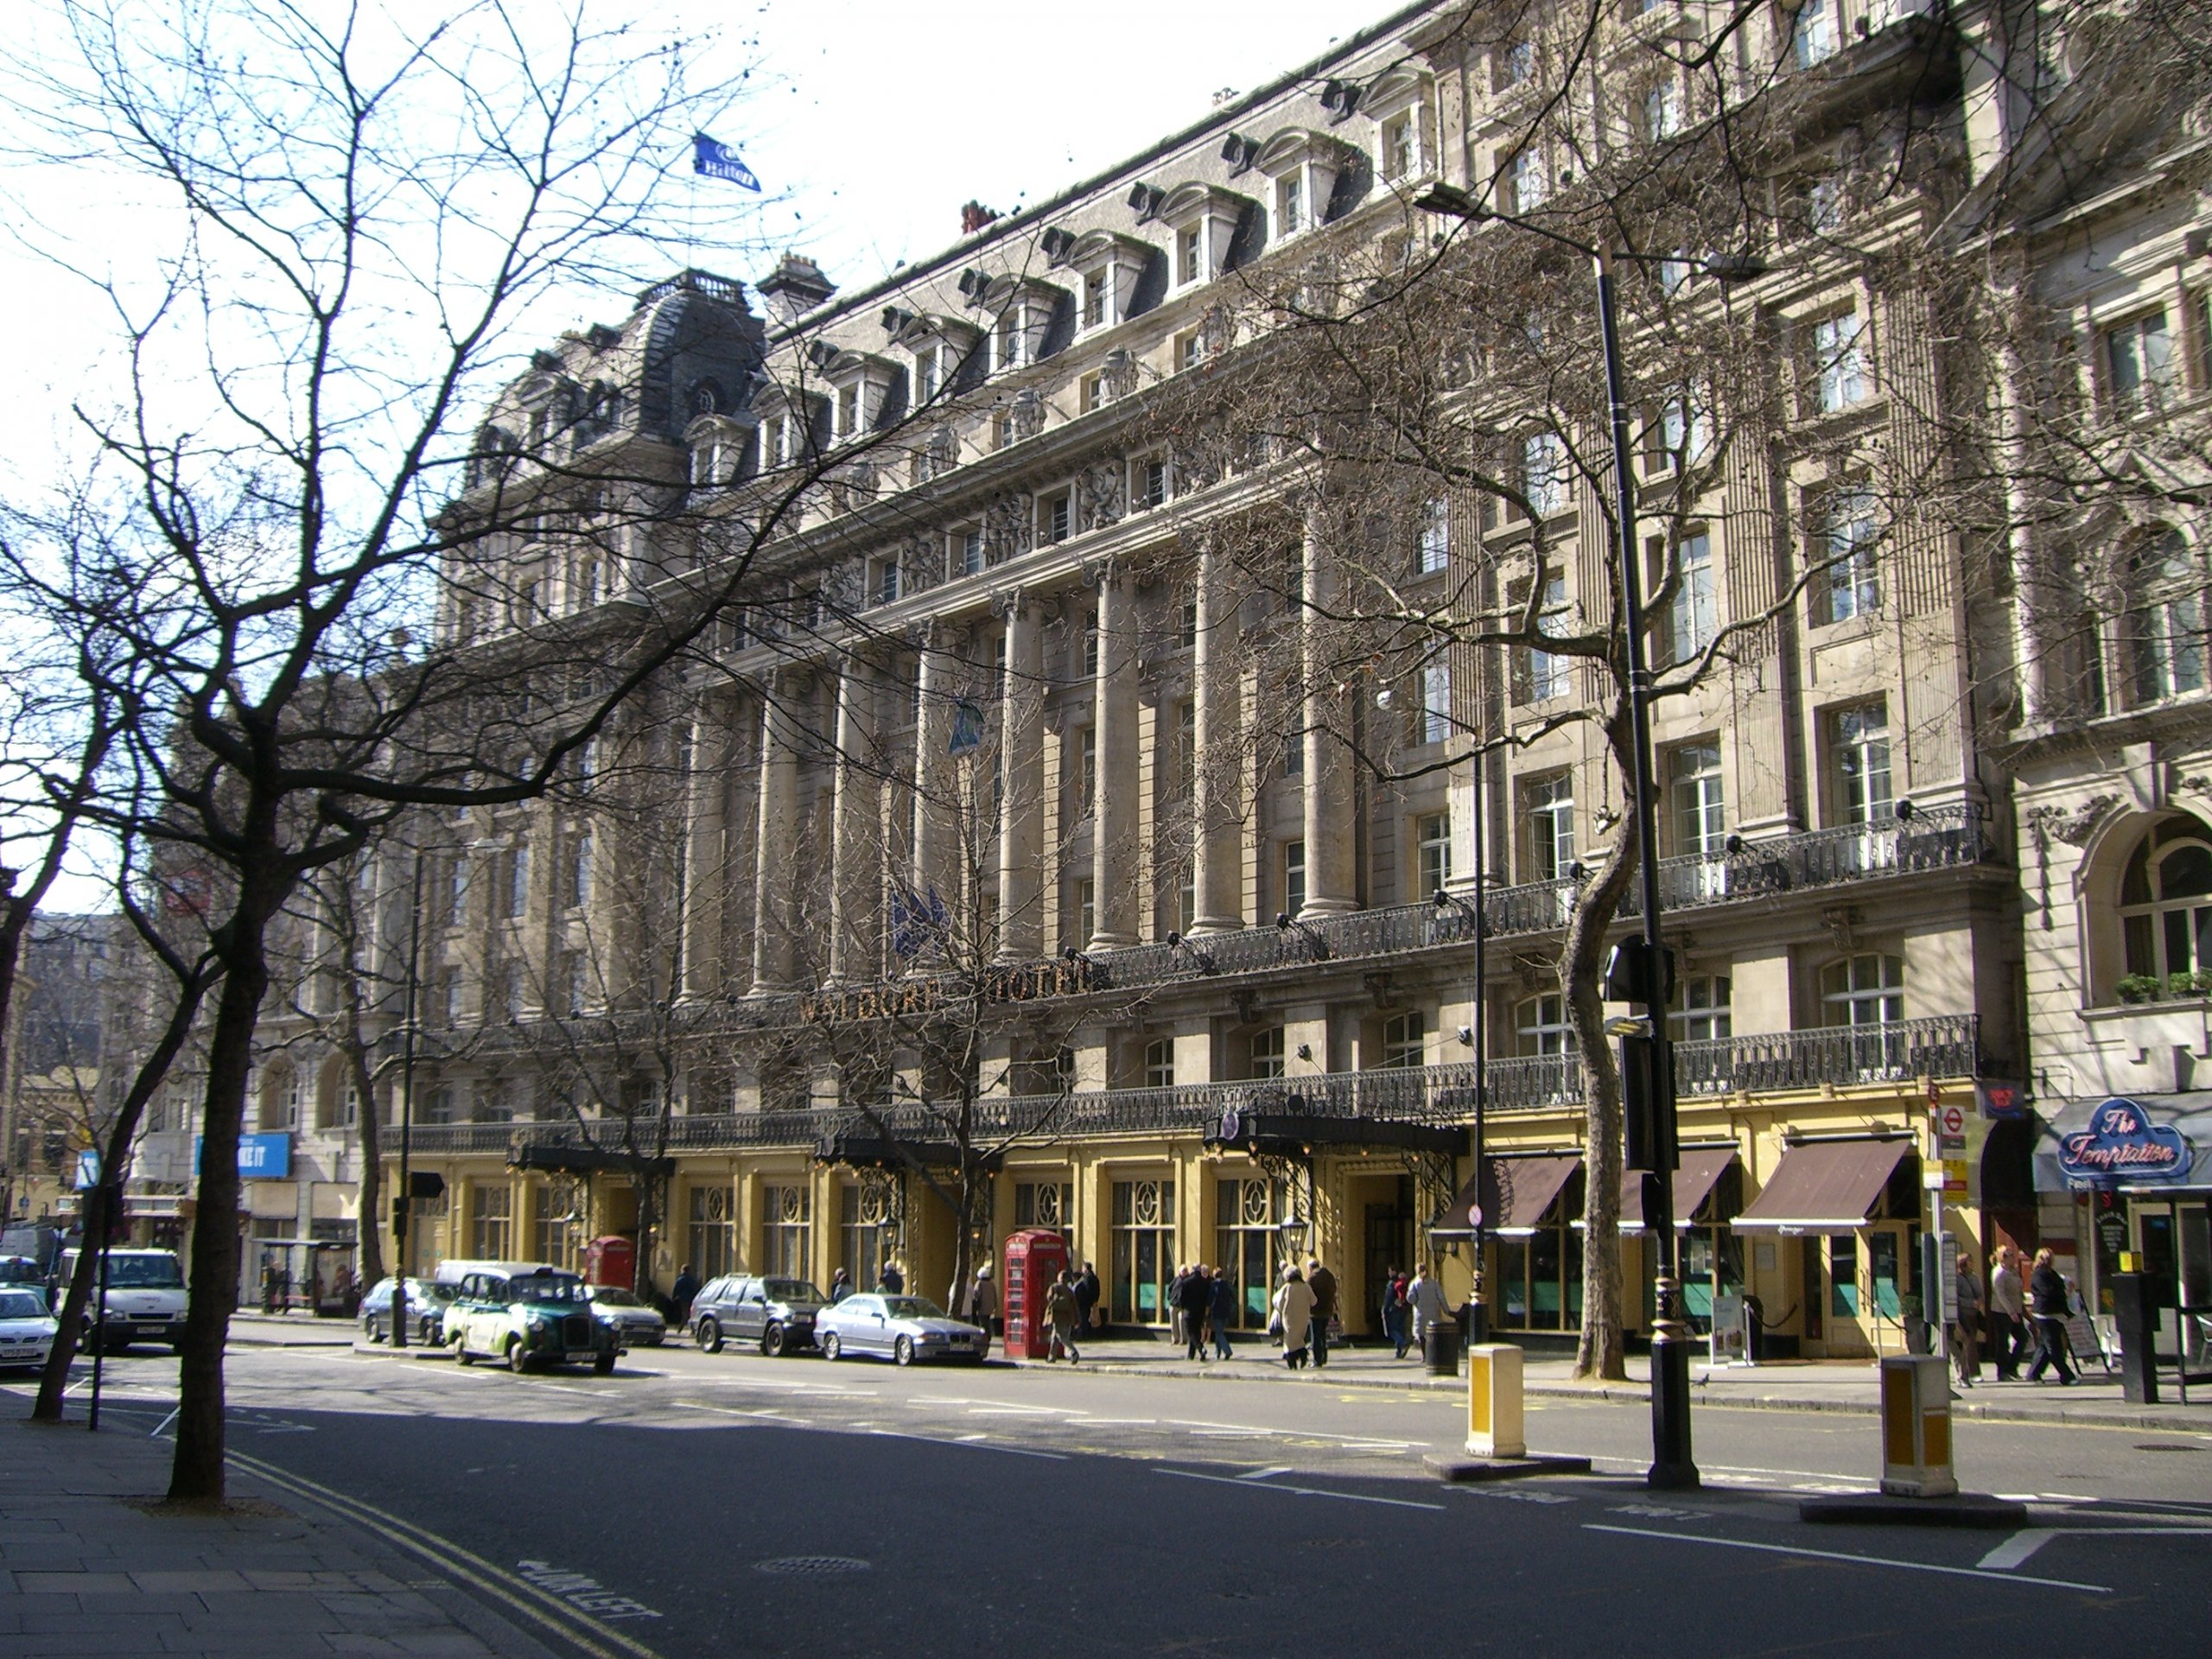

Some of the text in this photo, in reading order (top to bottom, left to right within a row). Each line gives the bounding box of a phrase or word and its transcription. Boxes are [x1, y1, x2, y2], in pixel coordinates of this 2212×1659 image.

[704, 159, 753, 188] Hilton
[2101, 1109, 2137, 1135] The
[2065, 1134, 2175, 1171] Temptation
[566, 1592, 664, 1619] LEFT
